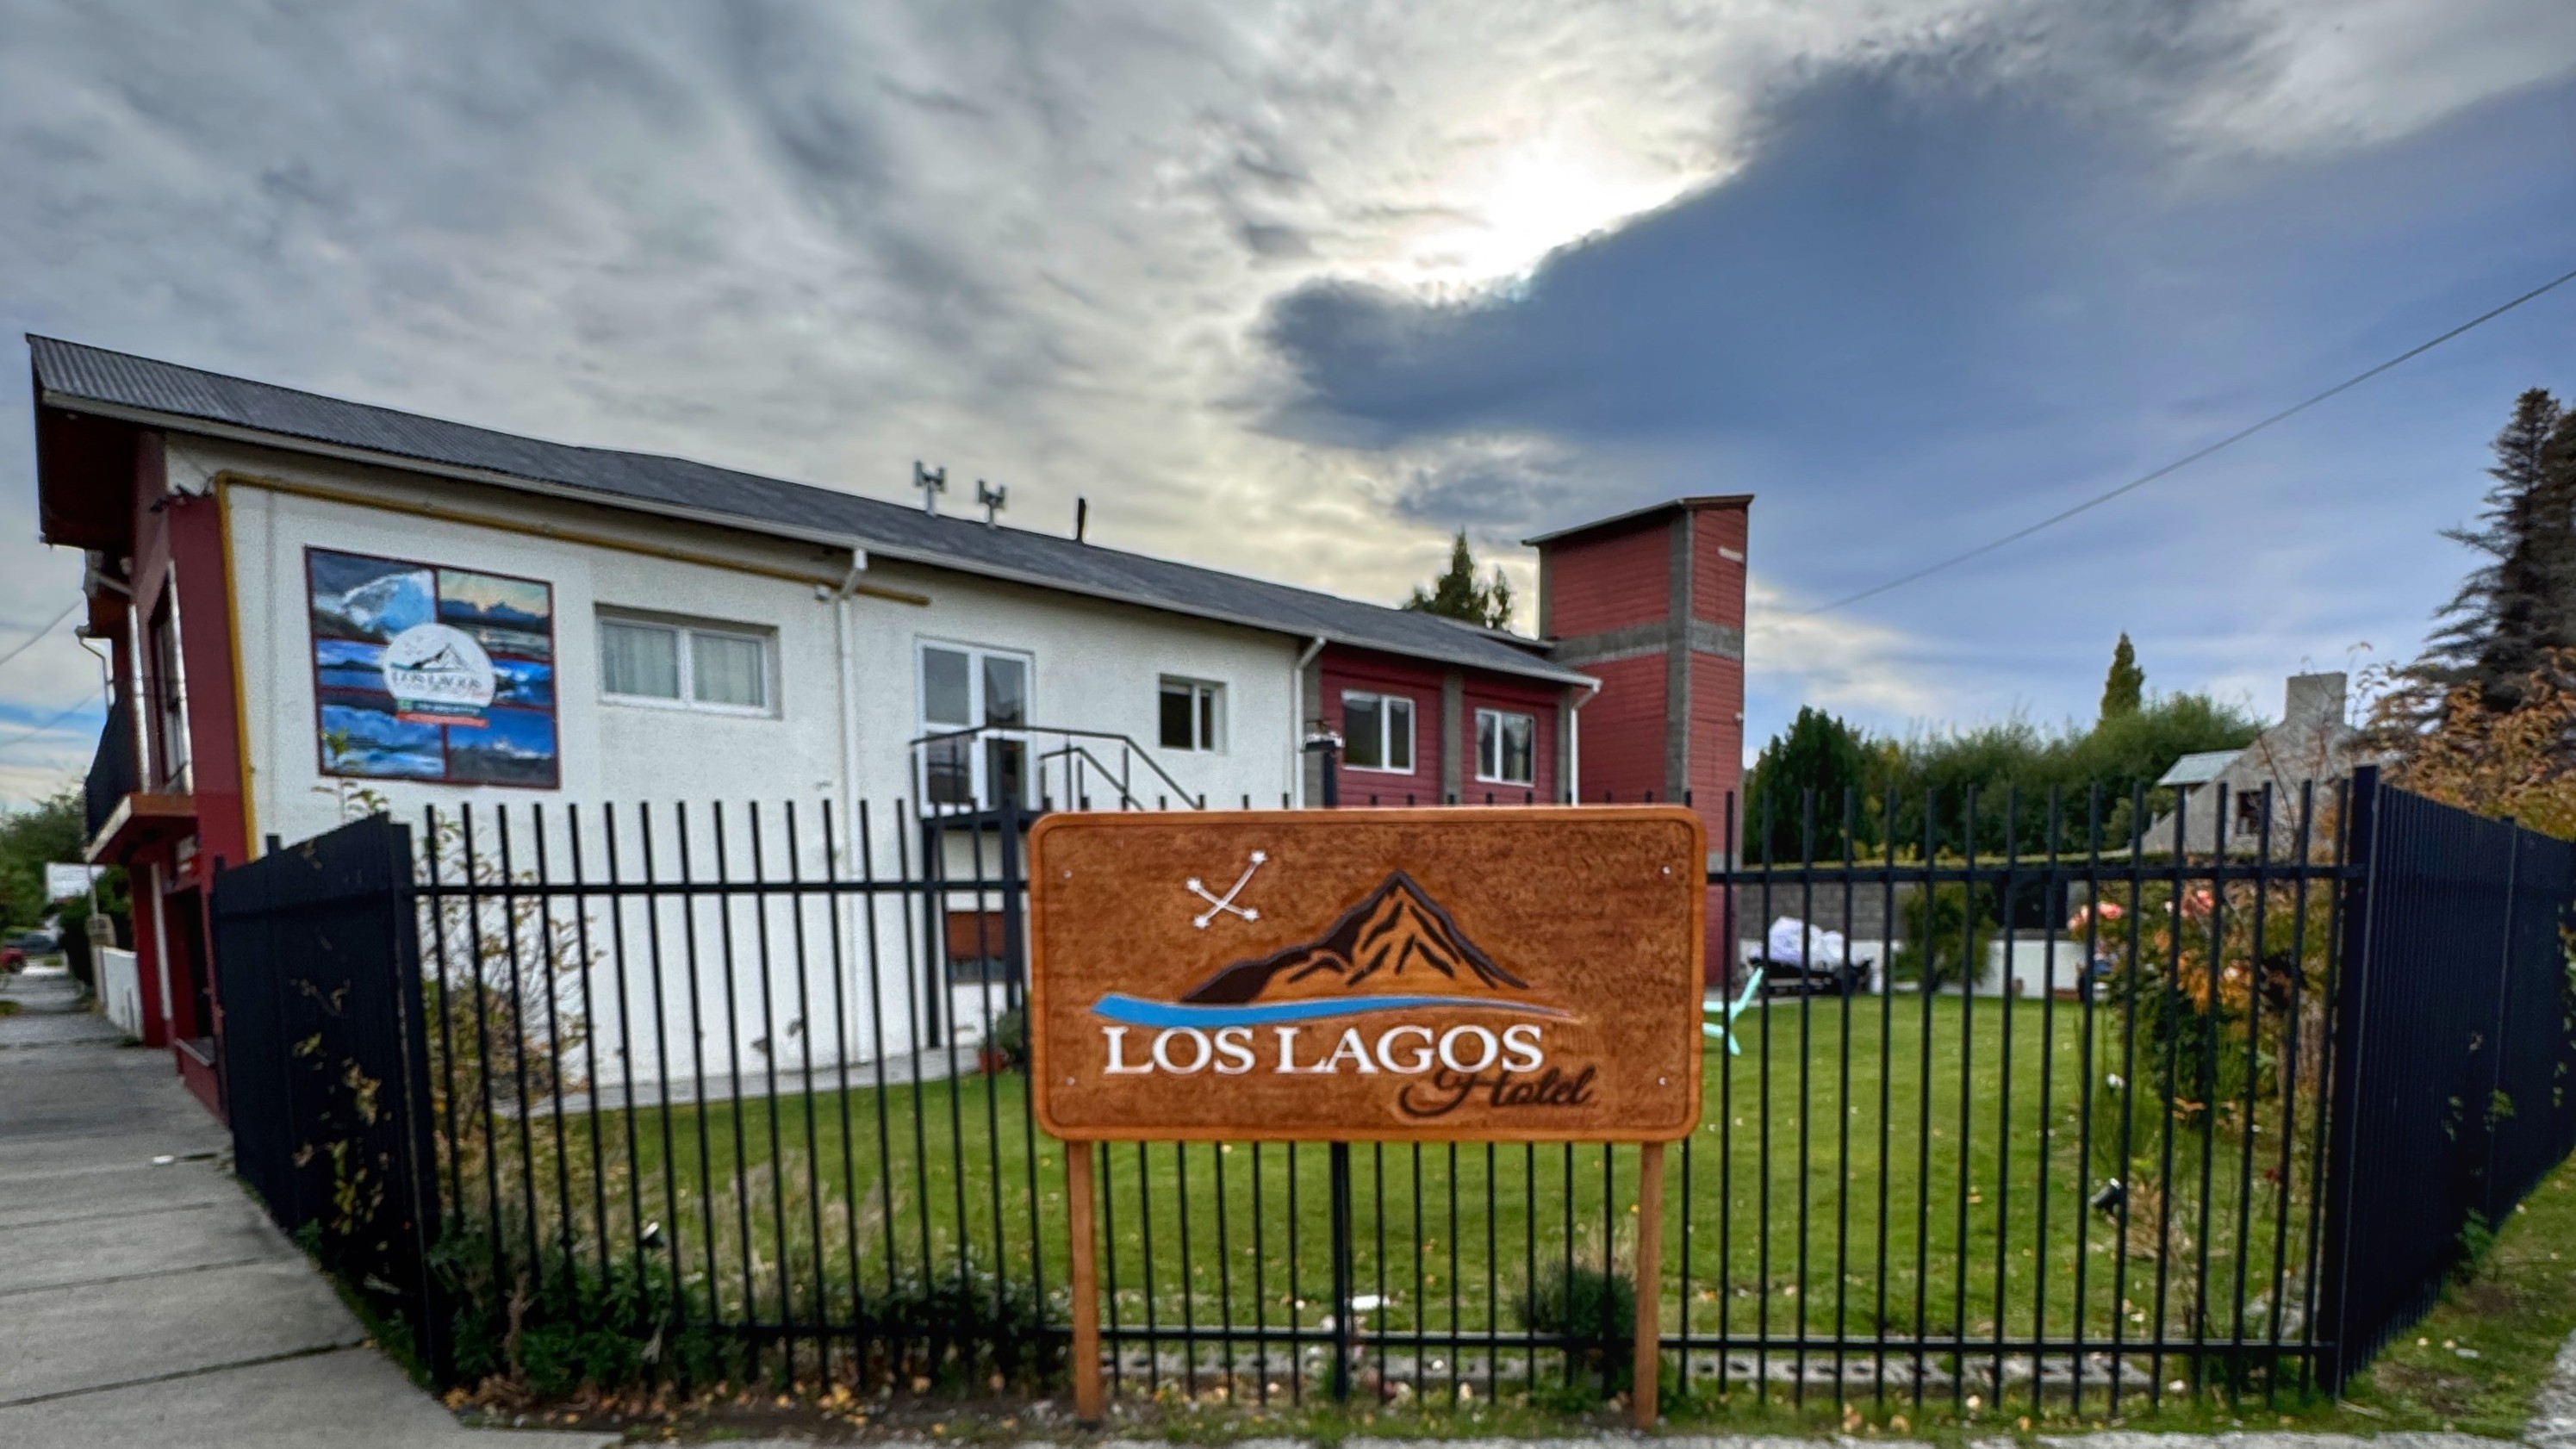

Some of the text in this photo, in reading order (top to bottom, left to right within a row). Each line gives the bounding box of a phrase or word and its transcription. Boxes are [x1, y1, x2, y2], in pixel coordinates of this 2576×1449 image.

[1102, 1023, 1544, 1074] LOS LAGOS
[1397, 1064, 1597, 1116] Hotel
